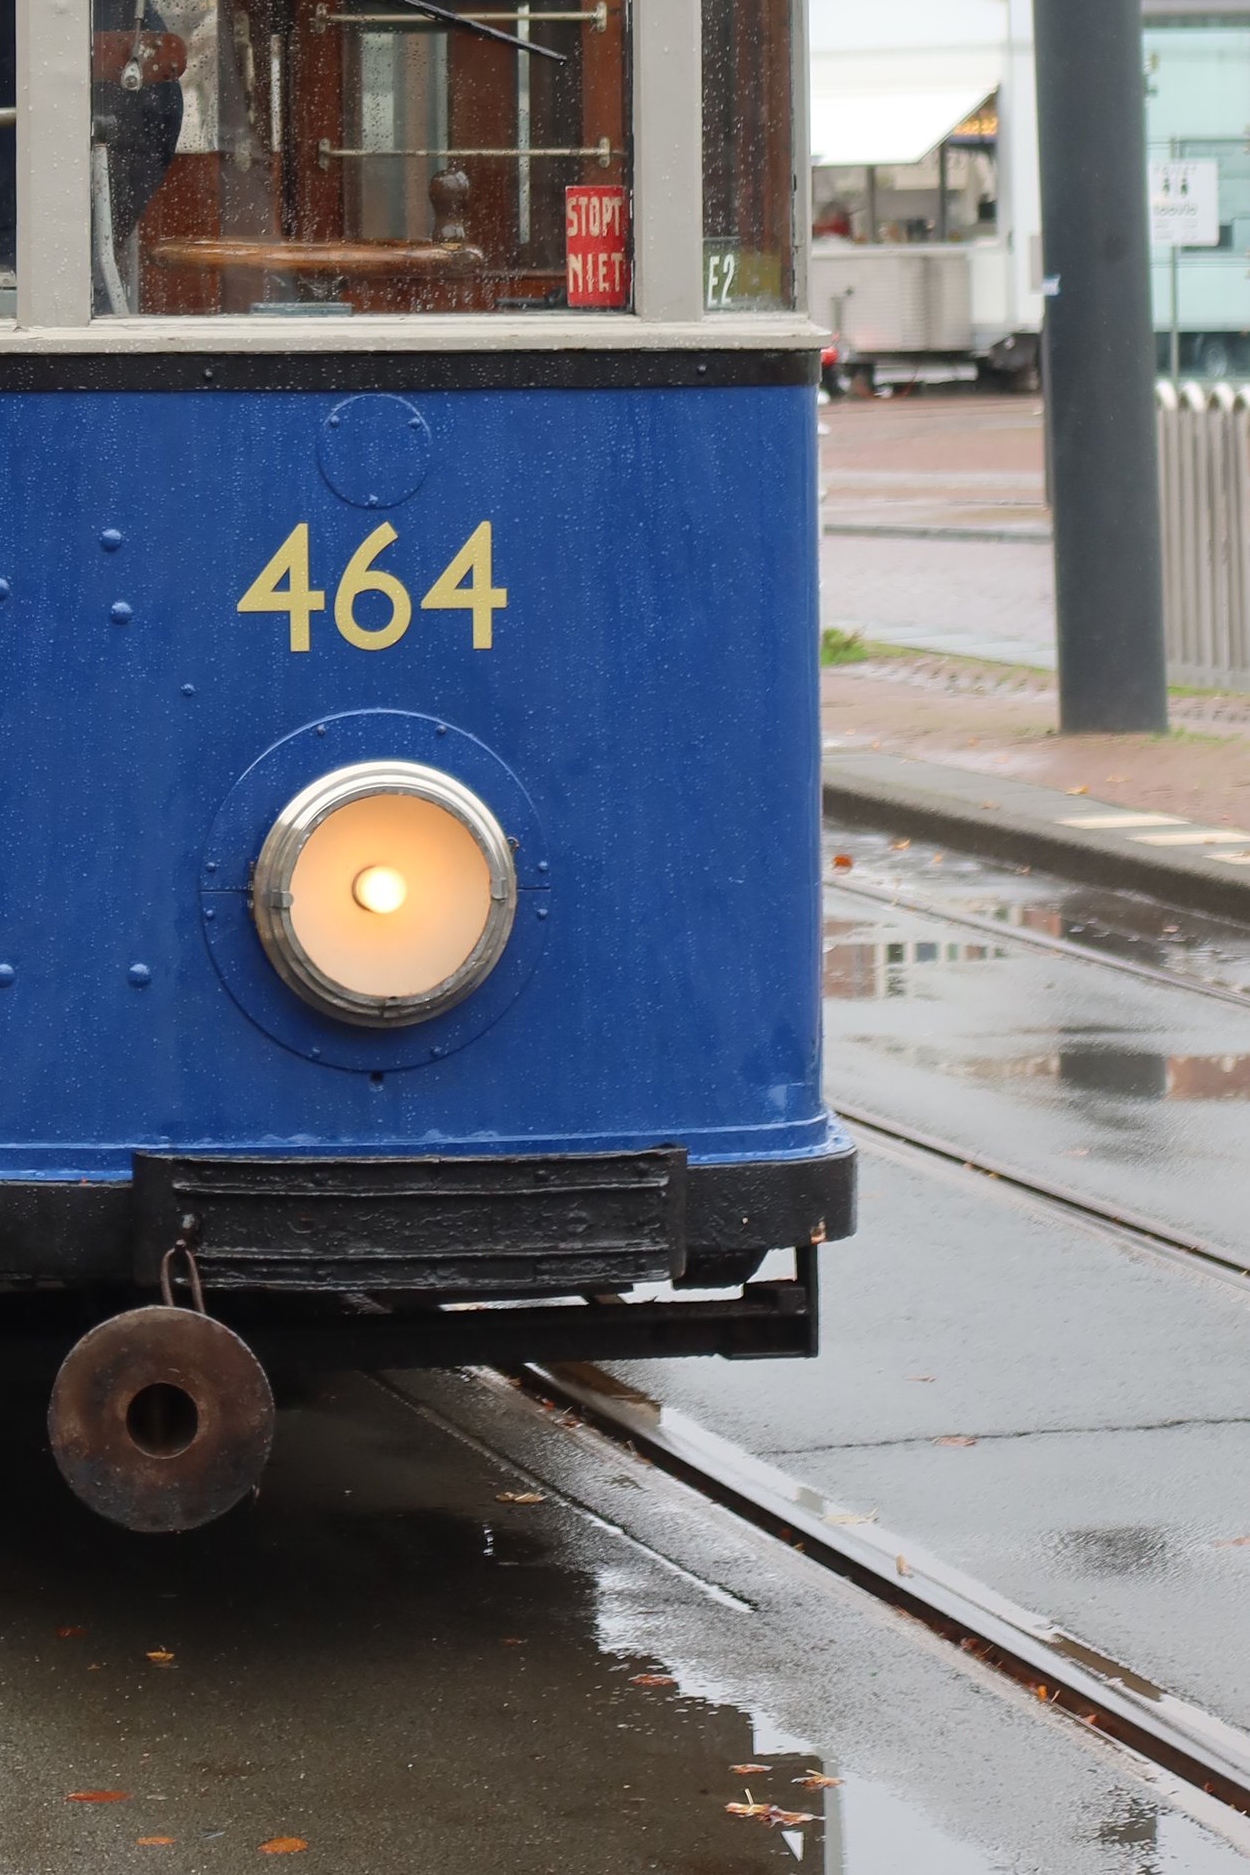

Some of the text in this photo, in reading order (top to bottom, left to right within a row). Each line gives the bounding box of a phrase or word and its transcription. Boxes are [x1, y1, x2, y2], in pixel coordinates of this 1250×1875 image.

[566, 195, 623, 238] STOPT
[567, 251, 624, 294] NIET
[706, 253, 736, 309] E2
[236, 520, 508, 653] 464
